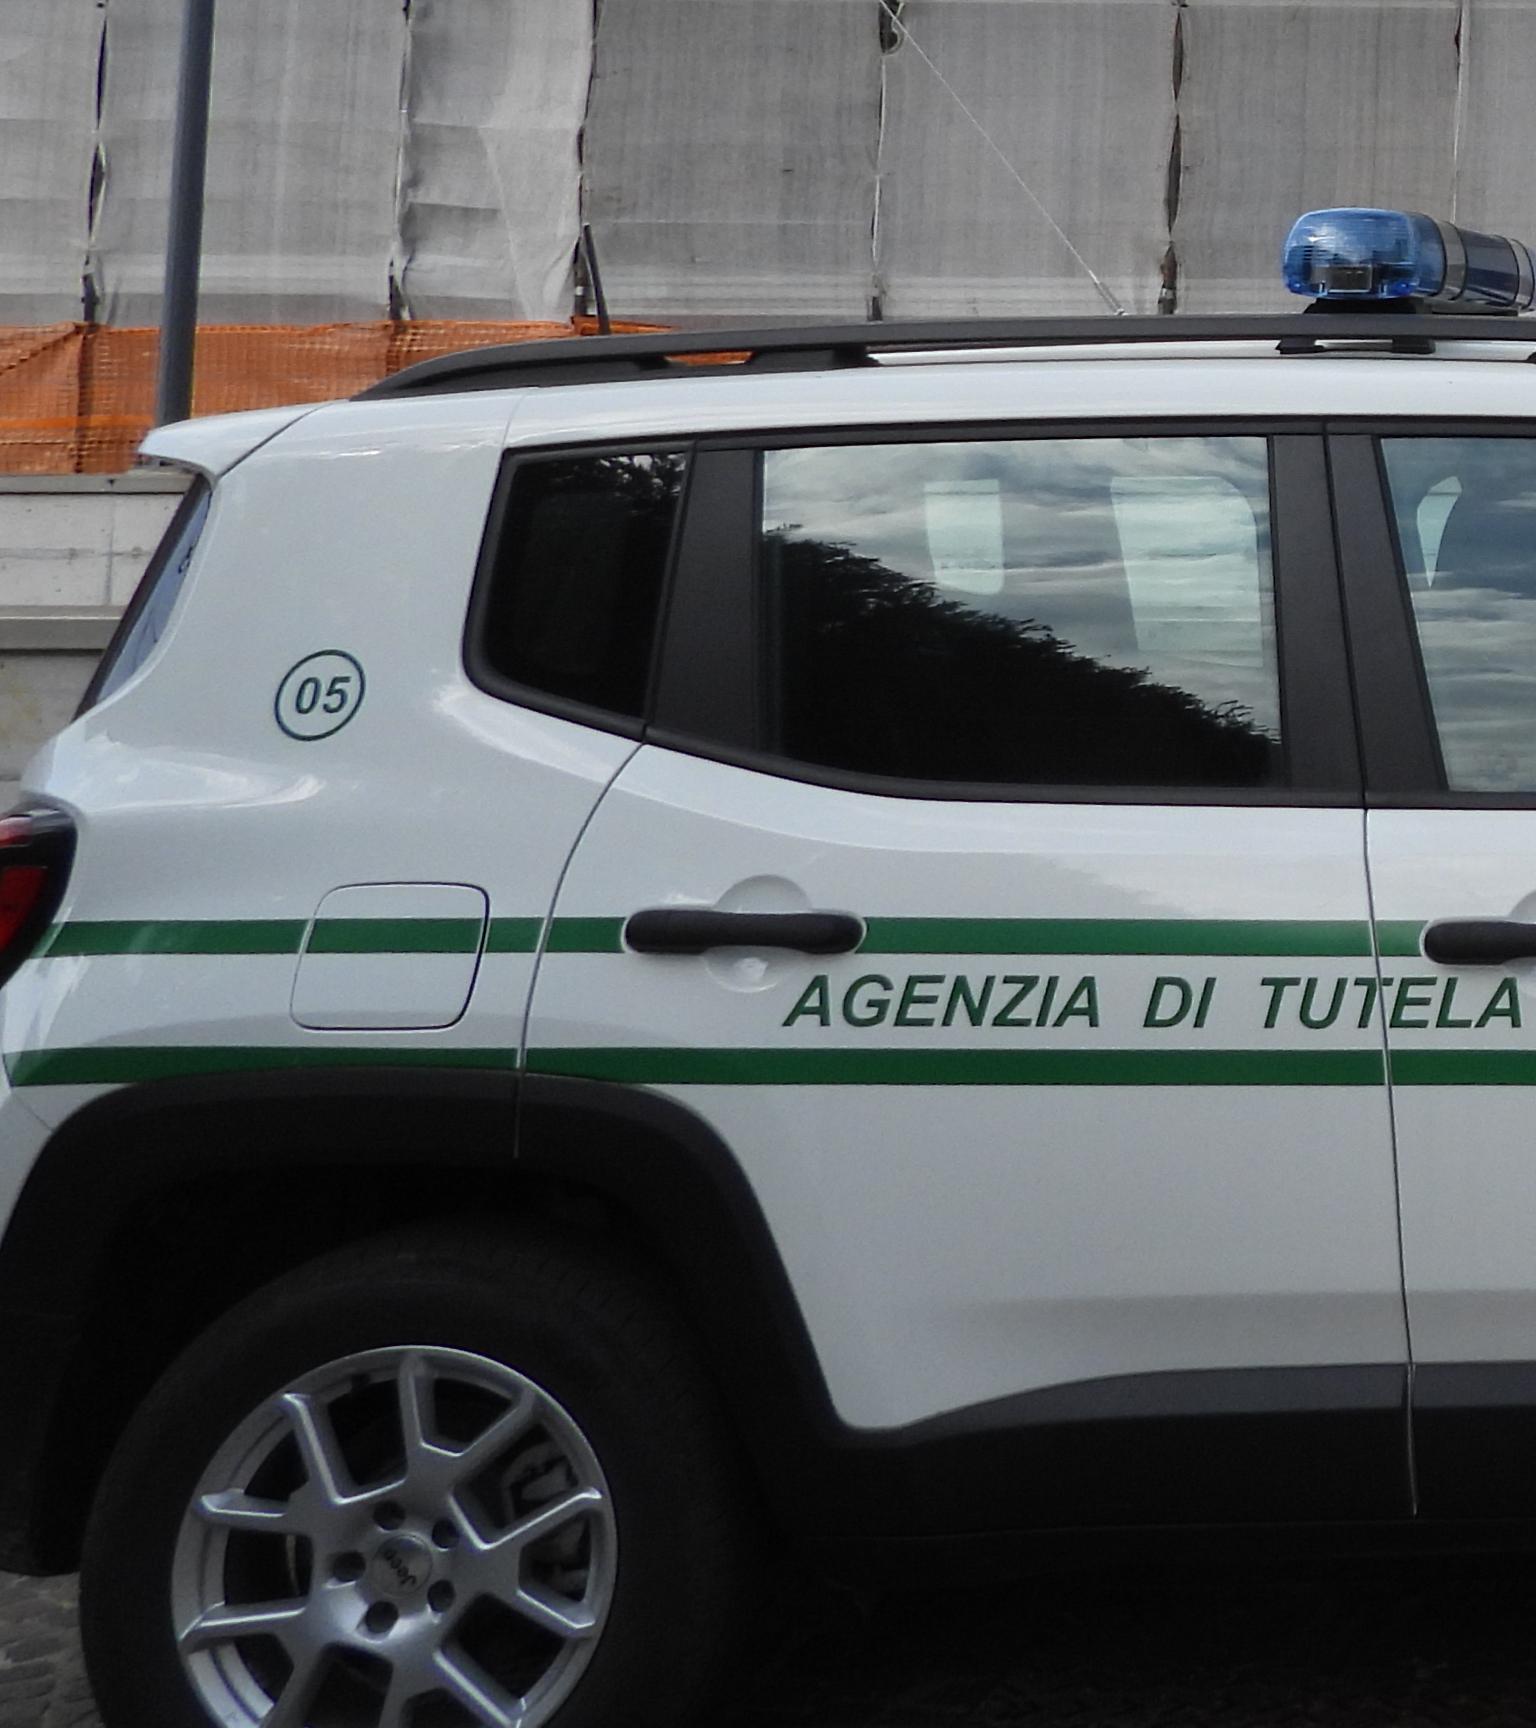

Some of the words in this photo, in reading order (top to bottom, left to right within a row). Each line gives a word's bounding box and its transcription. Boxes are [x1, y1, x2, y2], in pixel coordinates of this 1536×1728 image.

[295, 675, 352, 715] 05
[781, 974, 1100, 1028] AGENZIA
[1142, 976, 1218, 1030] DI
[1260, 976, 1523, 1030] TUTELA
